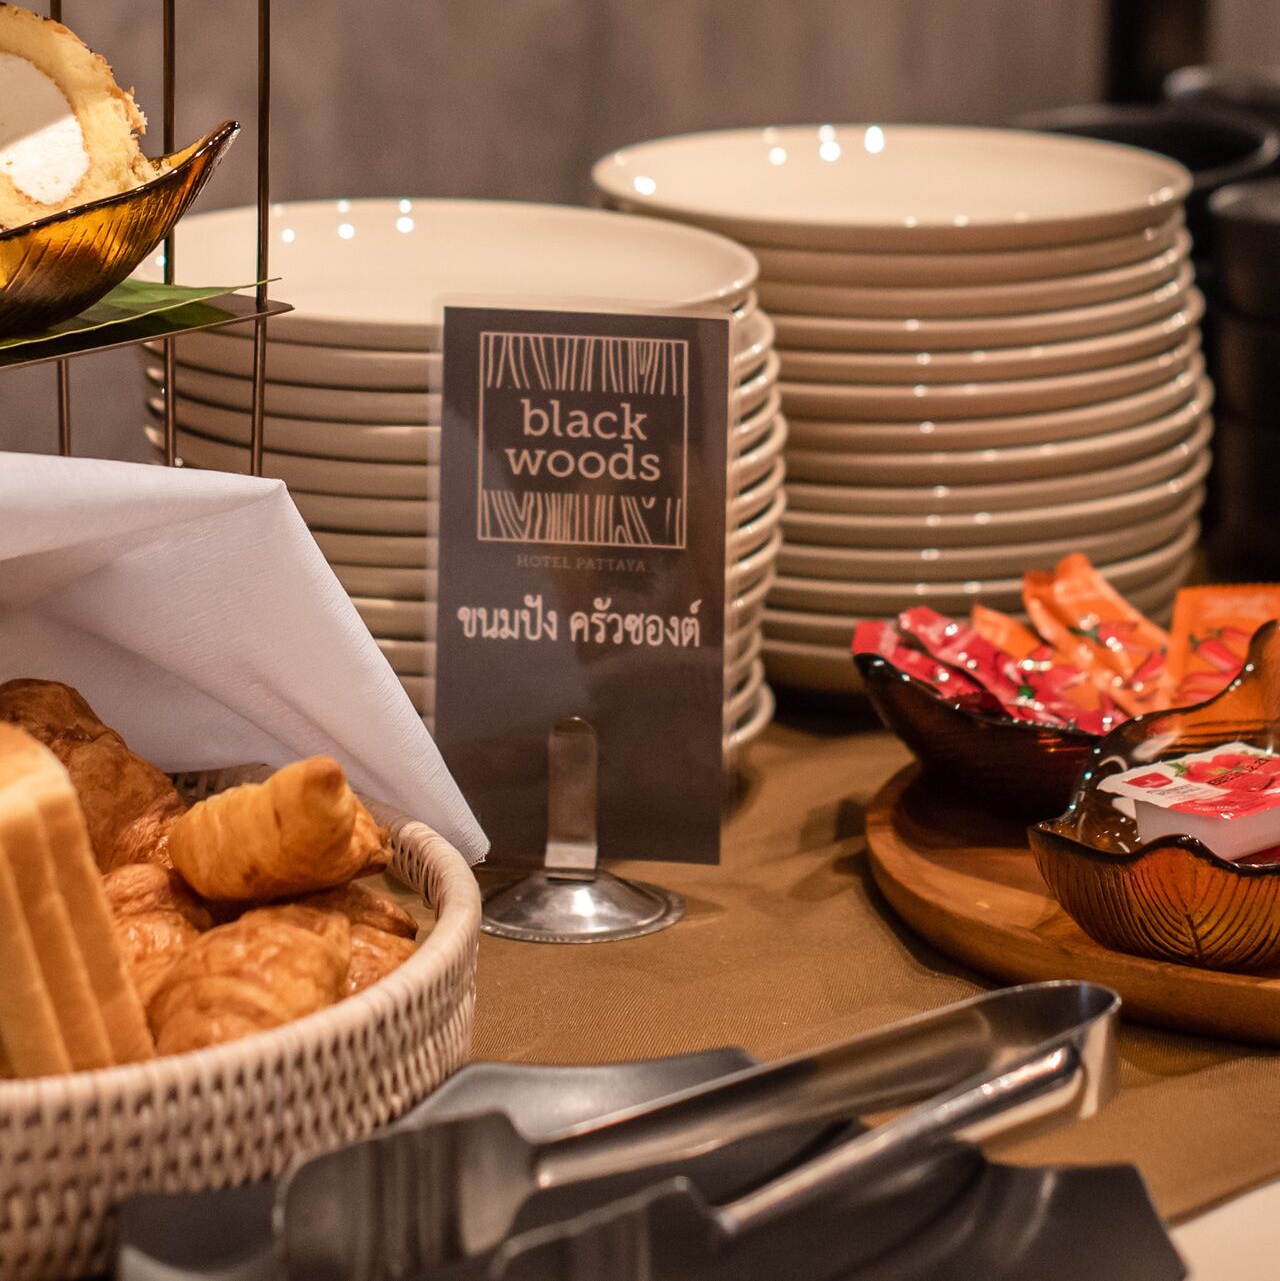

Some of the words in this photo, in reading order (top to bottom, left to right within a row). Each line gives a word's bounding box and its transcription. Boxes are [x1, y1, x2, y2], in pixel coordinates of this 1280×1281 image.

[520, 398, 648, 440] black
[504, 443, 661, 482] woods
[516, 554, 571, 569] HOTEL
[575, 556, 647, 573] PATTAYA
[456, 593, 558, 641] ขนมปัง
[569, 596, 703, 648] ครัวซองต์
